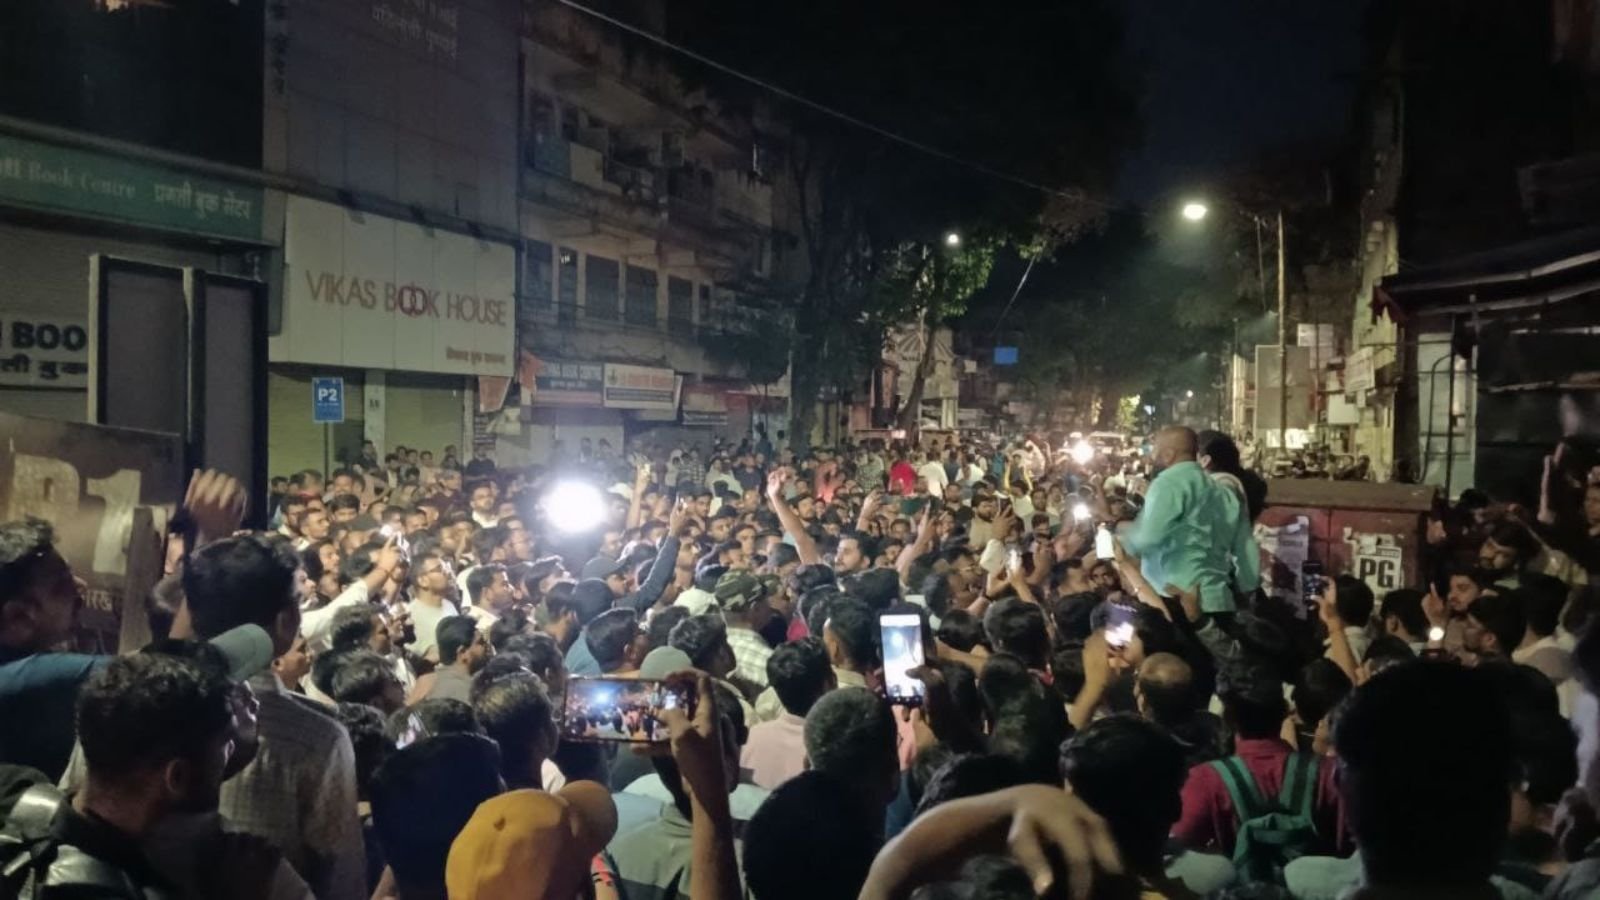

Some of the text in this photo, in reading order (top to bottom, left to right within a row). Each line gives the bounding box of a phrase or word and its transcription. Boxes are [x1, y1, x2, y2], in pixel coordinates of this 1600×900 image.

[28, 161, 72, 187] Book
[80, 174, 136, 199] Centre
[305, 269, 507, 326] VIKAS BOOK HOUSE
[317, 387, 338, 402] P2
[1360, 557, 1395, 588] PG
